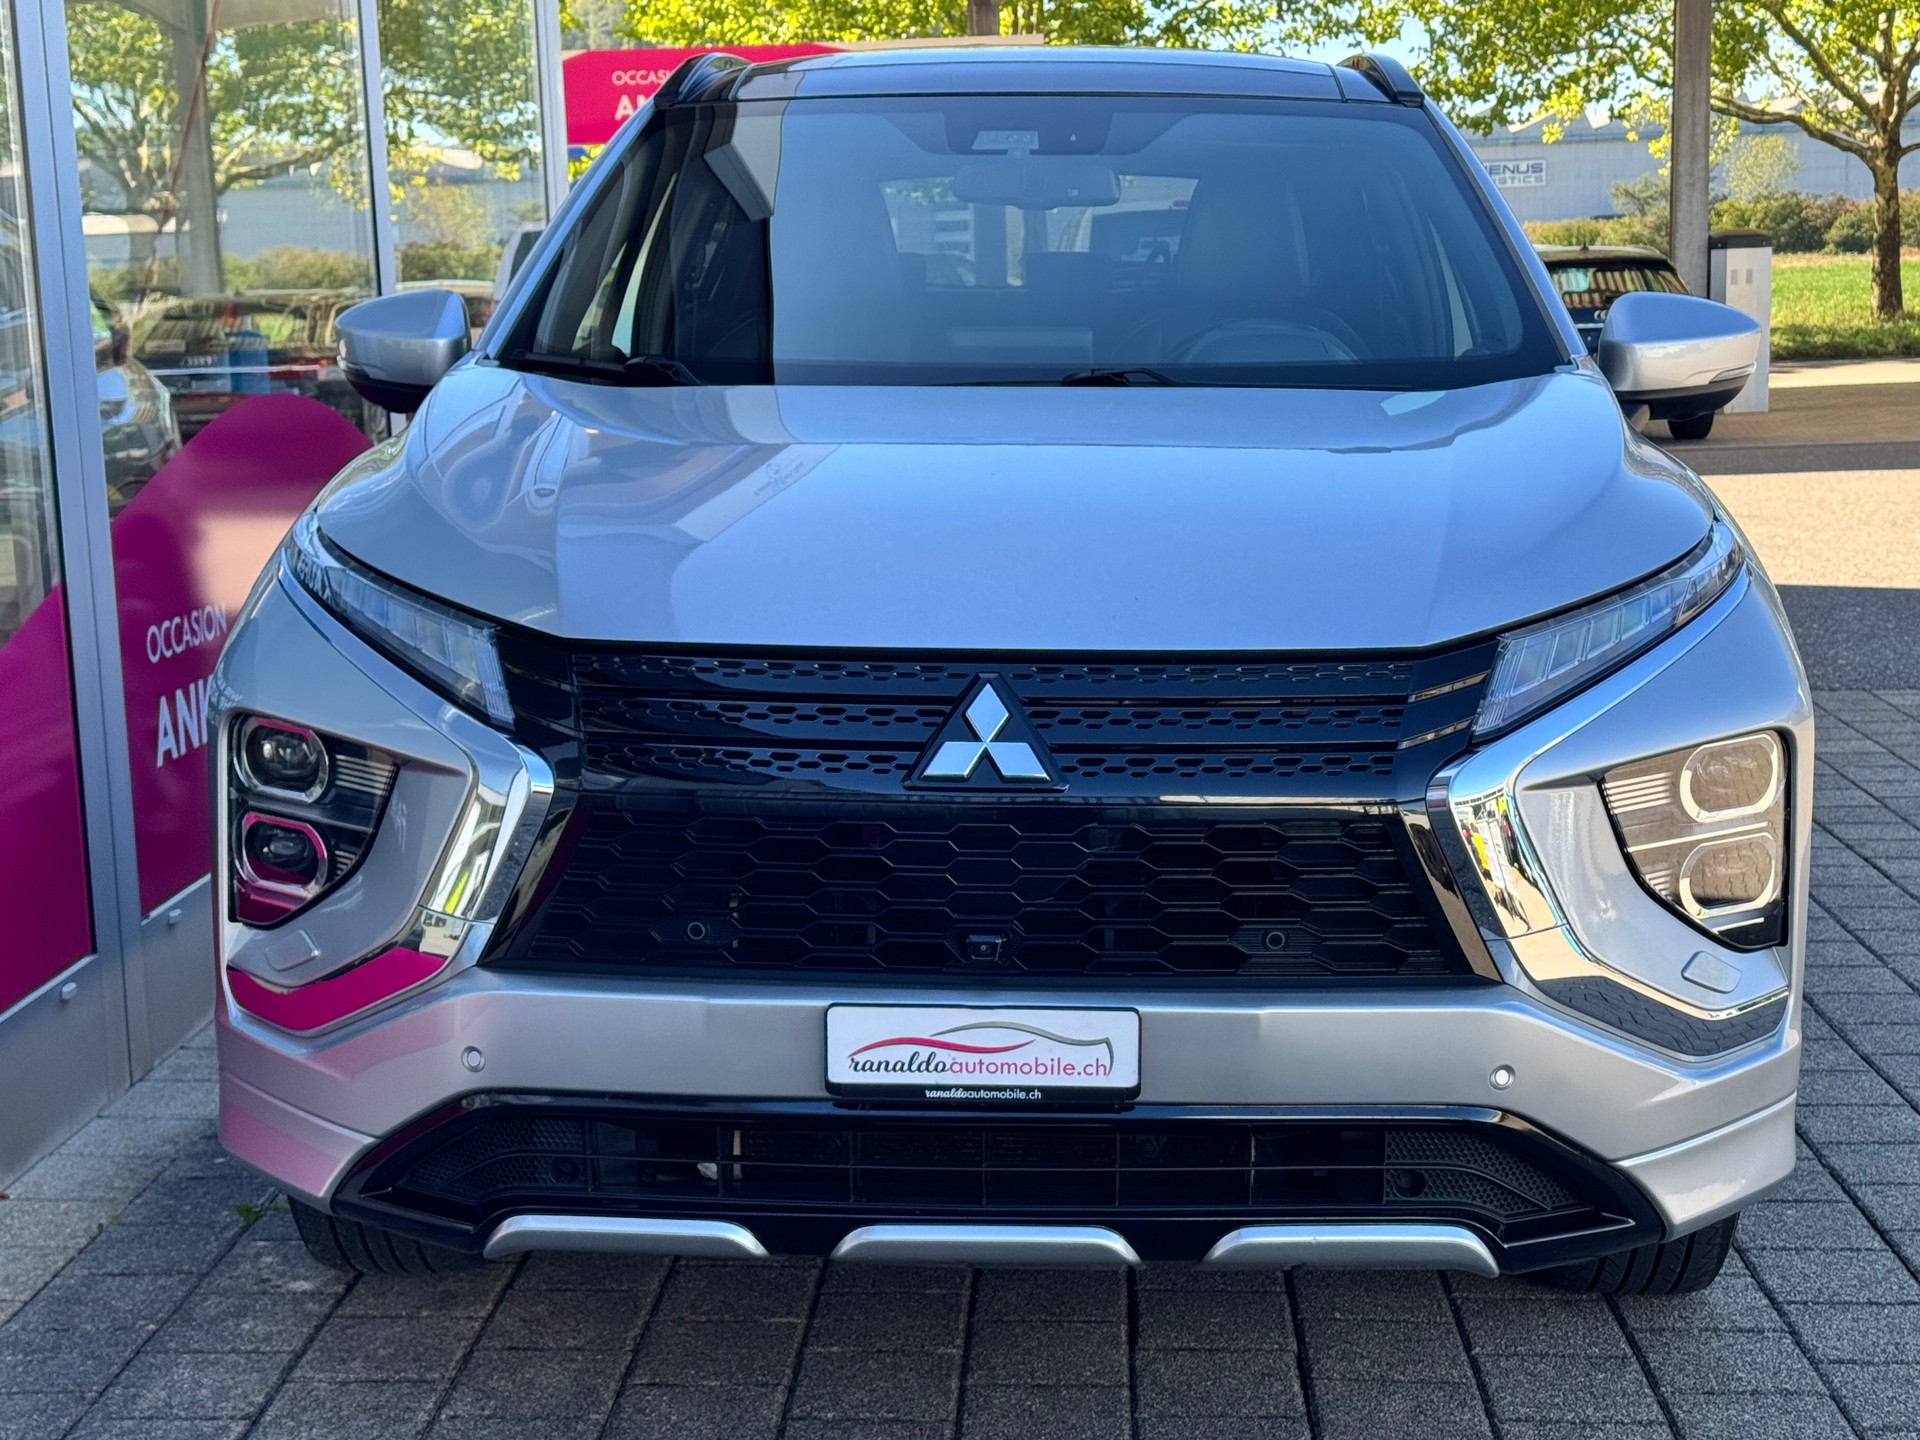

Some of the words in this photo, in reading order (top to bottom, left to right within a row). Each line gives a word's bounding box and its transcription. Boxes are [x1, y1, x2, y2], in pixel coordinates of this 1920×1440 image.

[1484, 162, 1544, 175] ENUS
[146, 602, 228, 664] OCCASION
[848, 1051, 1107, 1077] ranaldoautomobile.ch
[925, 1088, 1042, 1100] ranaldoautomobile.ch
